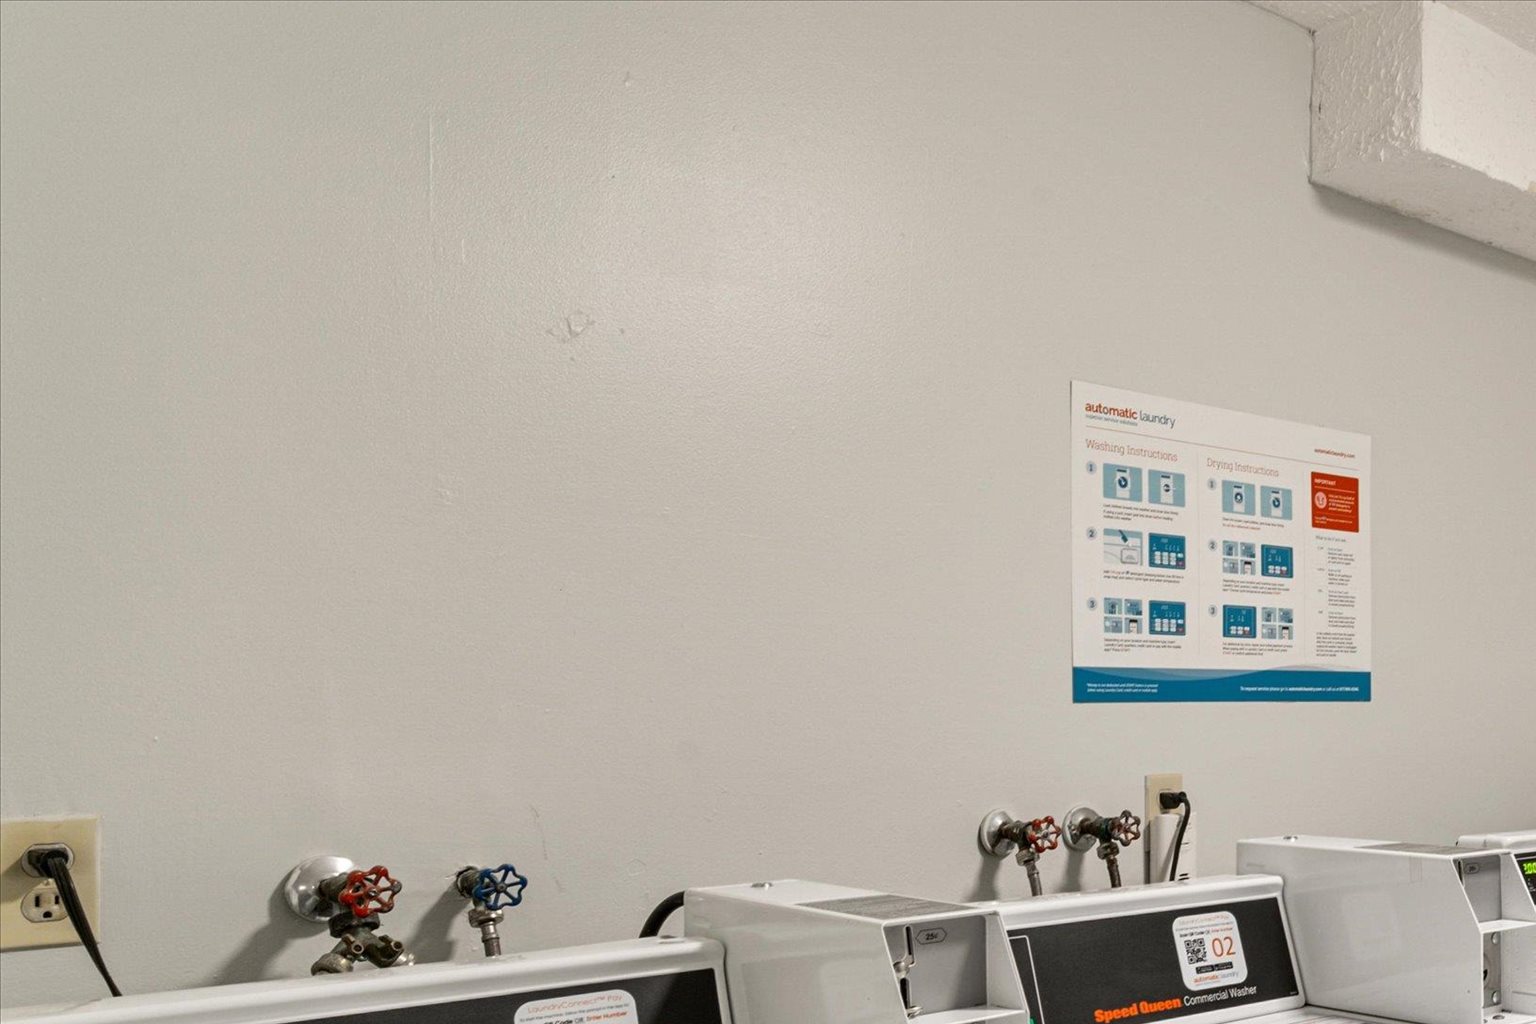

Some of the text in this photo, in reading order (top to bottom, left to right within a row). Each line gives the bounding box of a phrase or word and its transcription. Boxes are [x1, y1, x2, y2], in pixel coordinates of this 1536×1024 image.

[1085, 402, 1138, 420] automatic
[1140, 410, 1176, 429] laundry
[1085, 439, 1178, 462] Washing Instructions
[1207, 457, 1279, 477] Drying Instructions
[1212, 936, 1236, 957] 02
[1094, 985, 1257, 1024] Speed Queen Commercial Washer
